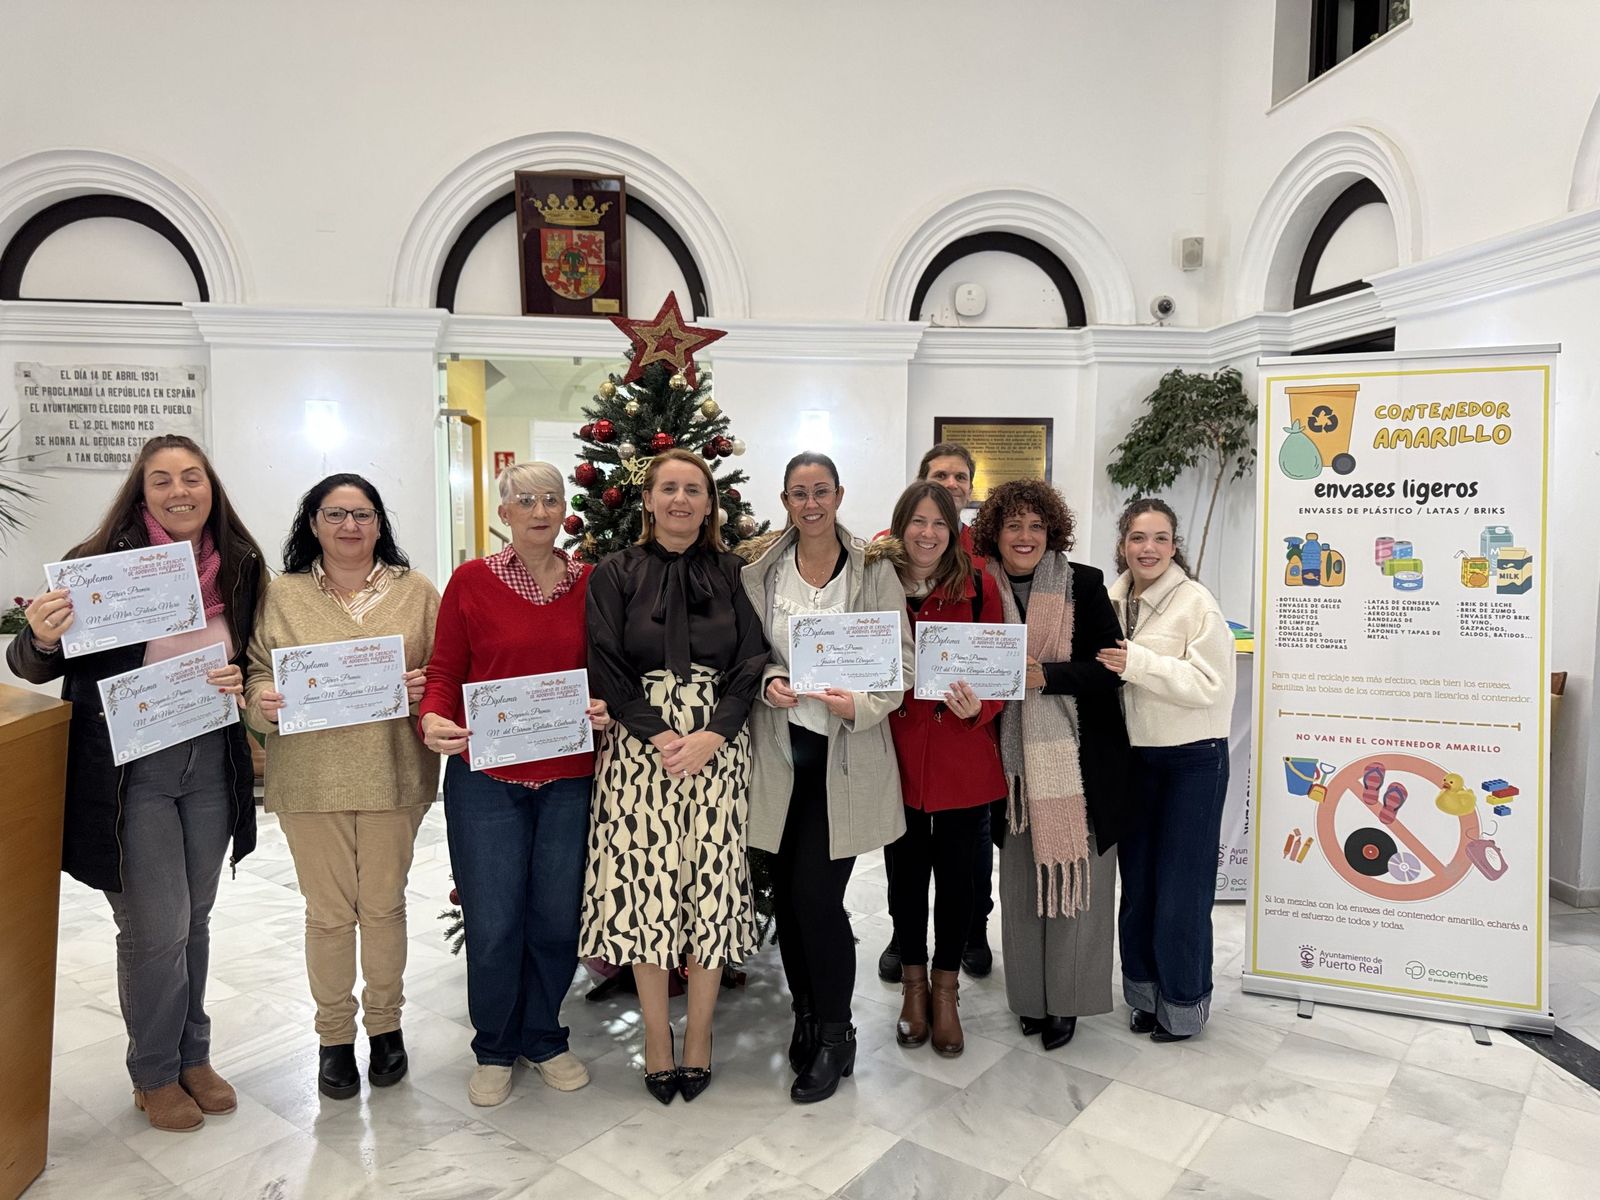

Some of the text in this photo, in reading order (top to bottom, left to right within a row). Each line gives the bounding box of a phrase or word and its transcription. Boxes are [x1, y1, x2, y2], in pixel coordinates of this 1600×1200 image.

[60, 369, 158, 381] EL DÍA 14 DE ABRIL 1931
[42, 387, 93, 397] PROCLAMADA
[96, 387, 105, 397] LA
[108, 386, 150, 398] REPÚBLICA
[154, 388, 164, 398] EN
[166, 387, 197, 398] ESPAÑA
[30, 403, 192, 414] EL AYUNTAMIENTO ELEGIDO POR EL PUEBLO
[1374, 401, 1511, 422] CONTENEDOR
[69, 420, 154, 430] EL 12 DEL MISMO MES
[35, 436, 46, 446] SE
[49, 436, 76, 446] HONRA
[80, 437, 90, 446] AL
[93, 436, 125, 446] DEDICAR
[1373, 424, 1511, 449] AMARILLO
[67, 453, 71, 462] A
[75, 453, 91, 462] TAN
[94, 452, 131, 462] GLORIOSA
[1314, 480, 1478, 505] envases ligeros
[1363, 506, 1413, 516] PLÁSTICO
[70, 574, 113, 588] Diploma
[803, 628, 834, 638] Diploma
[929, 635, 960, 646] Diploma
[291, 661, 329, 672] Diploma
[120, 683, 157, 700] Diploma
[481, 695, 518, 706] Diploma
[1296, 733, 1312, 742] NO
[1371, 738, 1441, 749] CONTENEDOR
[1446, 744, 1500, 753] AMARILLO
[1287, 898, 1317, 907] mezclas
[1350, 905, 1380, 914] envases
[1383, 907, 1395, 916] del
[1397, 910, 1445, 922] contenedor
[1448, 916, 1484, 927] amarillo,
[1487, 920, 1520, 930] echarás
[1301, 912, 1333, 922] esfuerzo
[1348, 917, 1370, 926] todos
[1320, 950, 1372, 963] Ayuntamiento
[1319, 958, 1382, 975] Puerto Real
[1429, 967, 1488, 982] ecoembes
